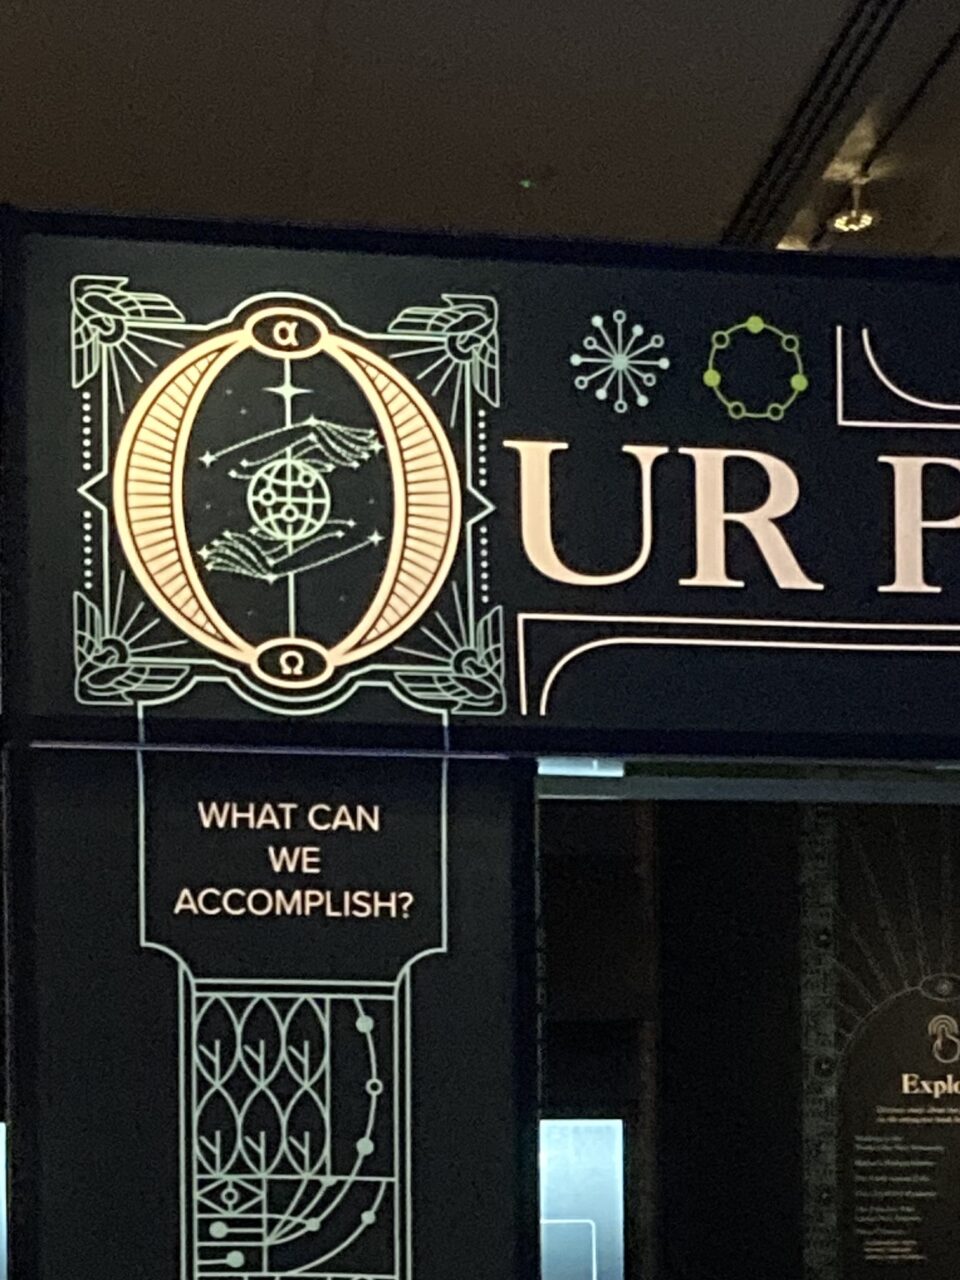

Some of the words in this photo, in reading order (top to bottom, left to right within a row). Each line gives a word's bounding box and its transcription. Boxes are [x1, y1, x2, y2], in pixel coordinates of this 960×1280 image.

[198, 801, 298, 830] WHAT
[307, 803, 380, 832] CAN
[267, 846, 321, 874] WE
[173, 887, 414, 919] ACCOMPLISH?
